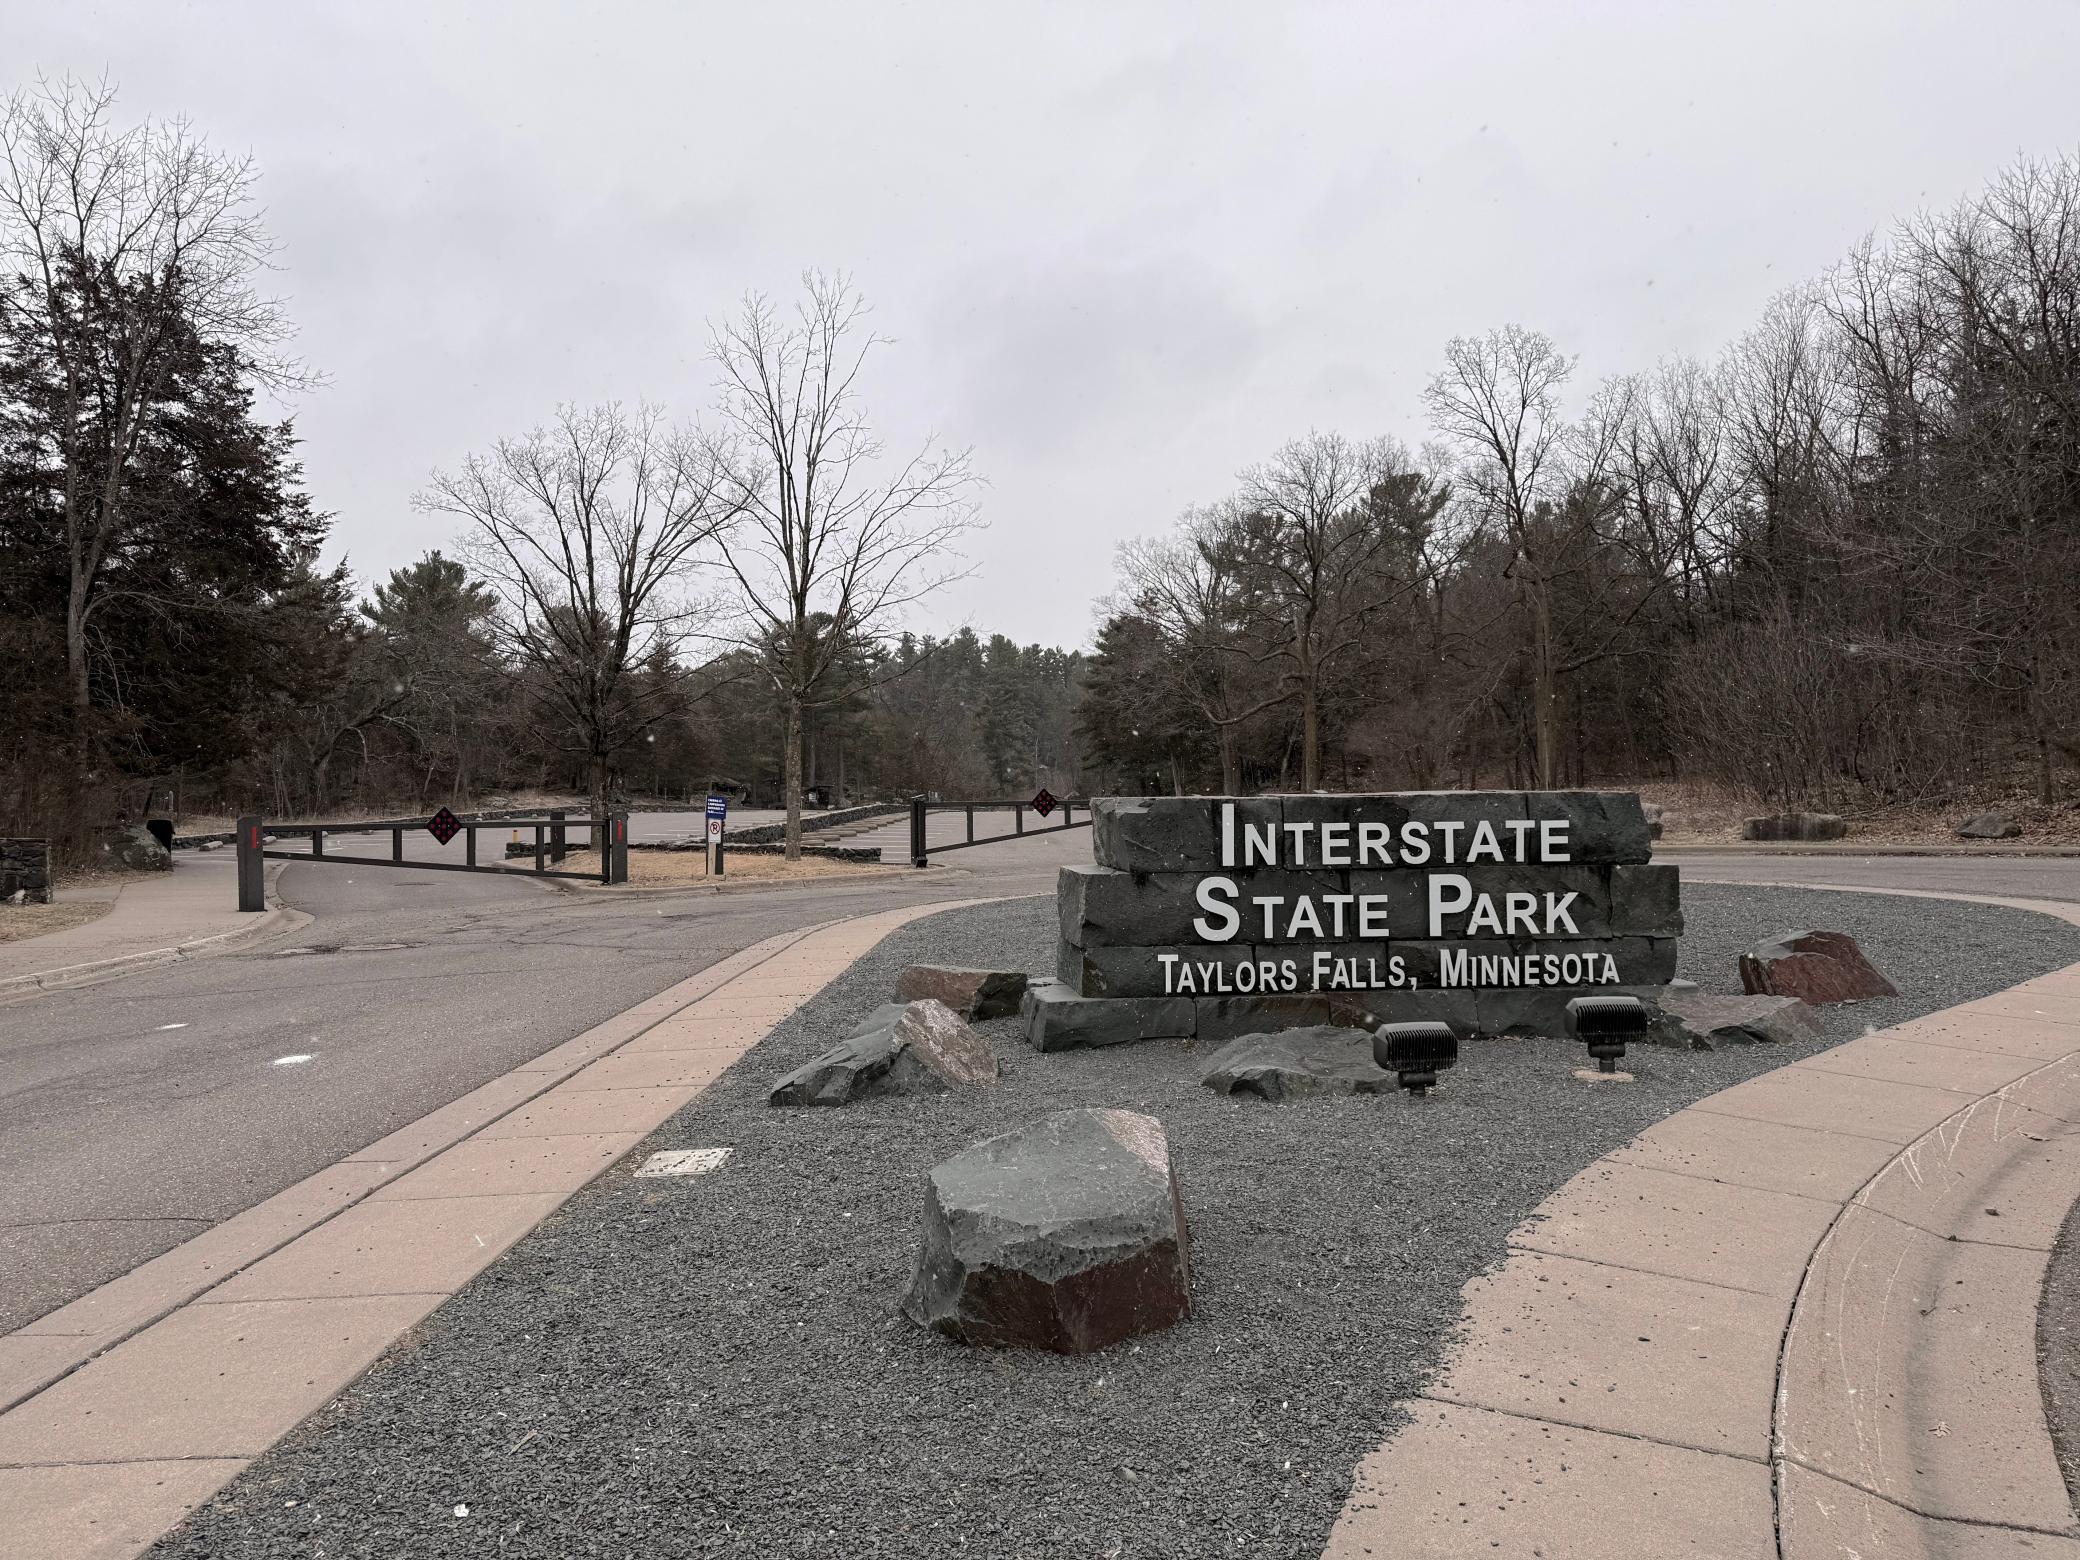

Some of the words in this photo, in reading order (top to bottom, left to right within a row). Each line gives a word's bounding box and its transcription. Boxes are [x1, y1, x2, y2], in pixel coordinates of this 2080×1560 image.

[1221, 803, 1571, 866] INTERSTATE
[1193, 877, 1389, 942] STATE
[1428, 874, 1580, 937] PARK
[1158, 955, 1297, 994] TAYLORS
[1312, 951, 1418, 992] FALLS,
[1440, 948, 1620, 988] MINNESOTA
